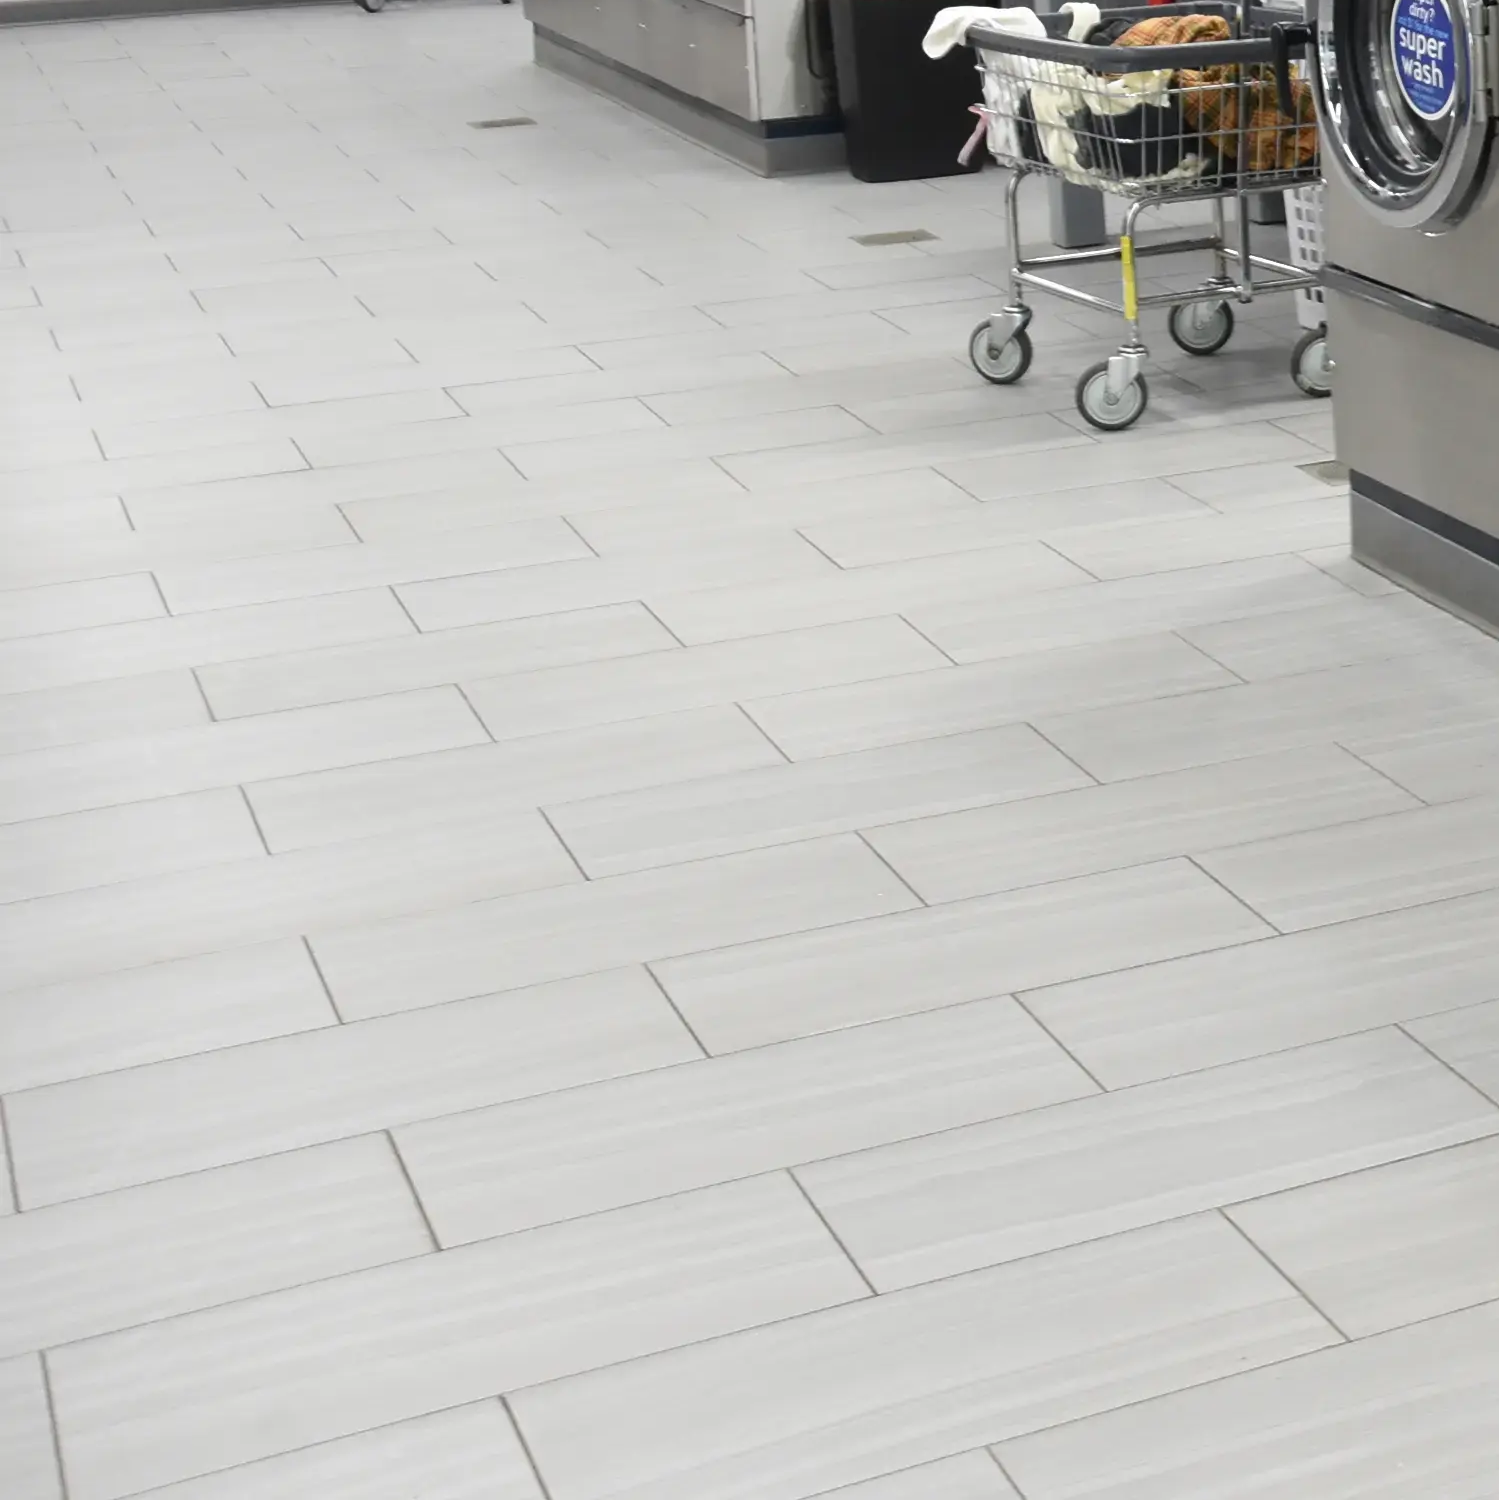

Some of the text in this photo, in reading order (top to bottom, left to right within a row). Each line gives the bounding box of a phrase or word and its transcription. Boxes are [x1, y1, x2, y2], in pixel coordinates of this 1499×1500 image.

[1408, 2, 1436, 23] dirty?
[1398, 26, 1446, 61] super
[1400, 55, 1444, 89] wash
